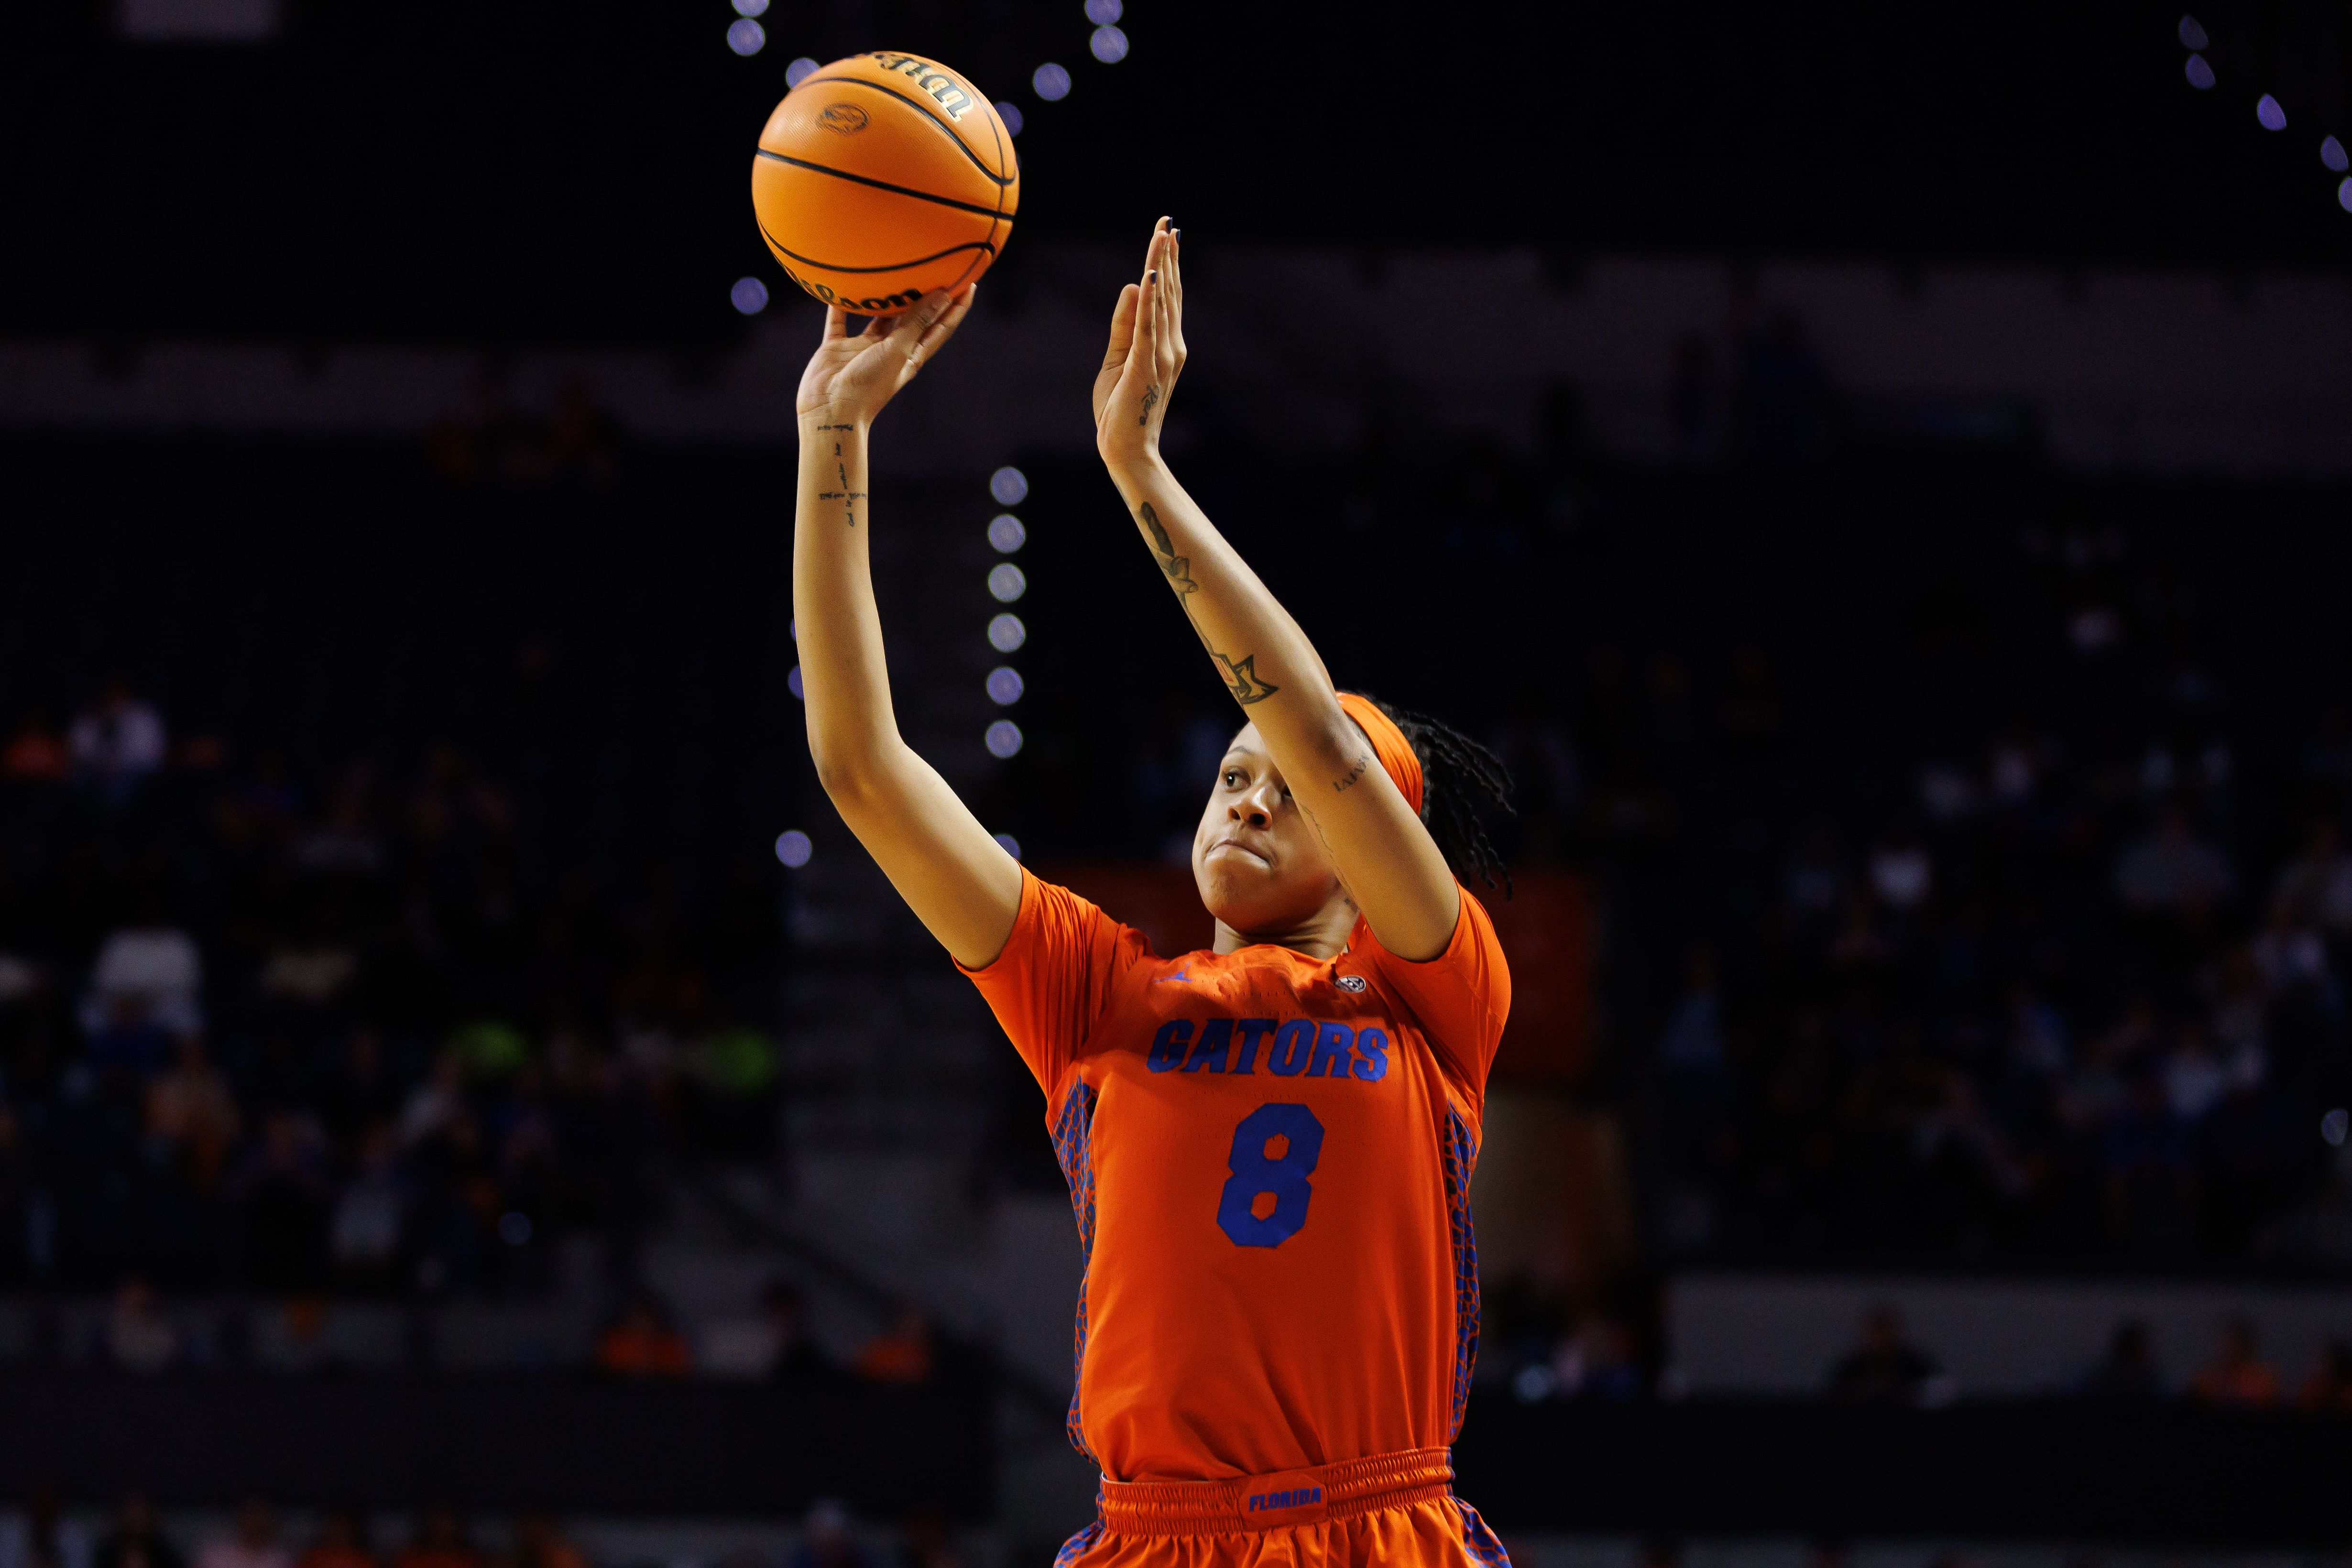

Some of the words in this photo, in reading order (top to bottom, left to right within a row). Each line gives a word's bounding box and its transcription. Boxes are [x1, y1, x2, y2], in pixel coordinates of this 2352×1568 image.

[1147, 1019, 1389, 1082] GATORS
[1216, 1102, 1325, 1248] 8
[1248, 1486, 1322, 1513] FLORIDA
